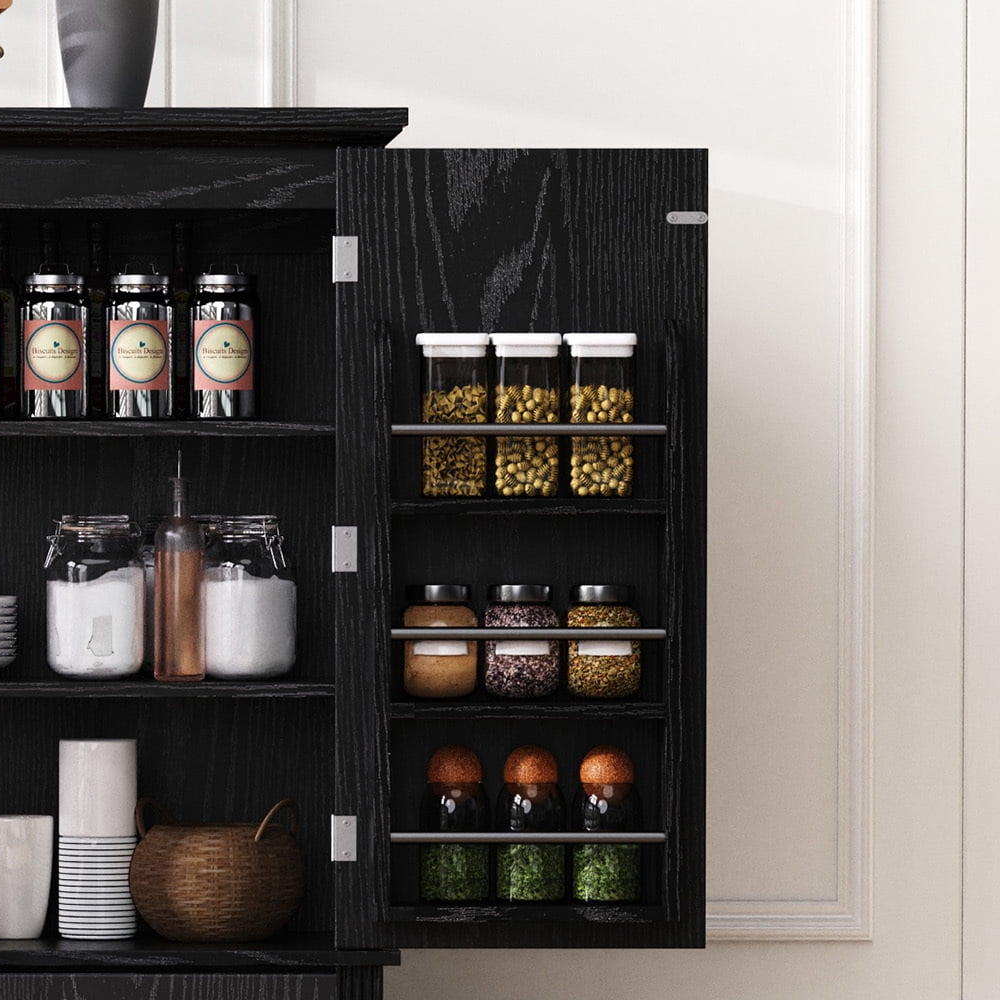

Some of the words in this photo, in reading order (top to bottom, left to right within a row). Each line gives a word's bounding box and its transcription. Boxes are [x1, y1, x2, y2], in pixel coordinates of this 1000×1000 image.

[57, 347, 78, 356] Design
[143, 347, 164, 356] Design
[228, 347, 249, 356] Design
